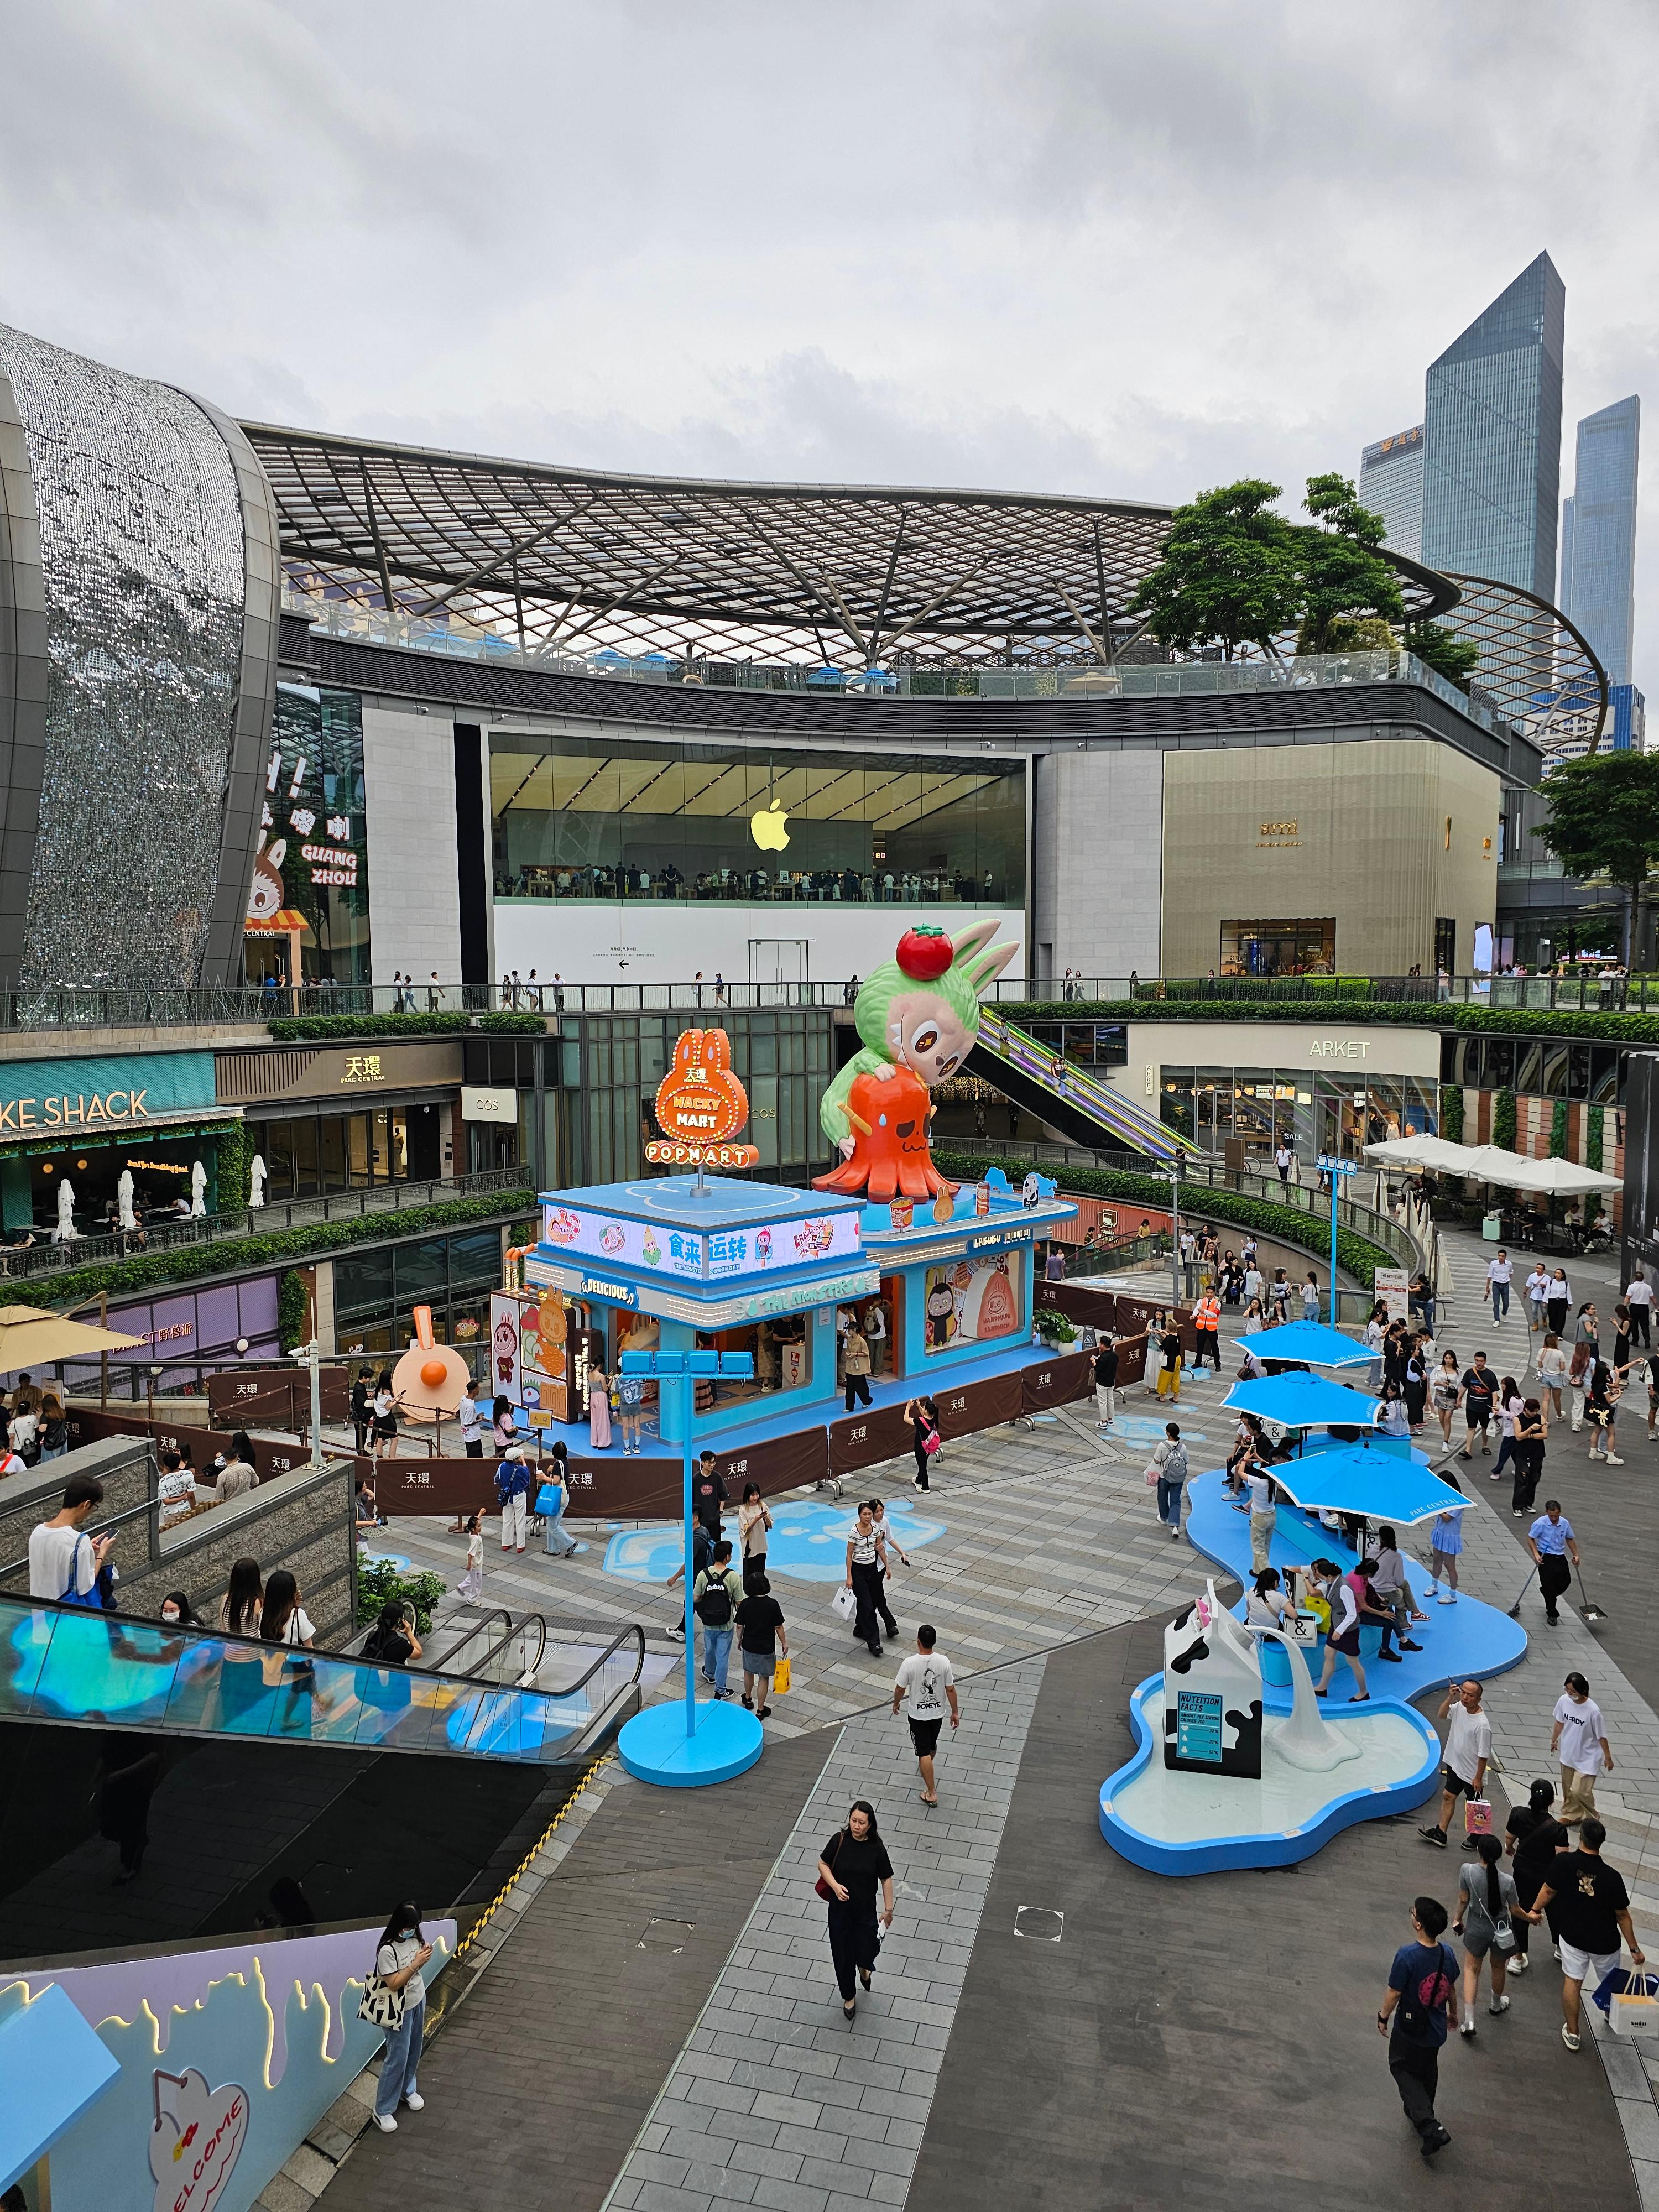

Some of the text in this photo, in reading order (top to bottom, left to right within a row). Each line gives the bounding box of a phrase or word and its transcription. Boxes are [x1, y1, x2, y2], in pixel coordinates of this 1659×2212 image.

[302, 845, 357, 869] GUANG
[312, 868, 357, 886] ZHOU
[1309, 1040, 1370, 1058] ARKET
[346, 1055, 381, 1077] 天環
[44, 1089, 149, 1125] SHACK
[476, 1099, 499, 1111] COS
[673, 1095, 721, 1111] WACKY
[676, 1113, 717, 1129] MART
[751, 1108, 776, 1119] COS
[41, 1125, 86, 1136] CUSTARD
[90, 1123, 116, 1132] FRIES
[120, 1118, 154, 1129] SHAKES
[206, 1110, 237, 1119] CONES
[973, 1234, 1001, 1248] LABUBU
[588, 1279, 629, 1301] DELICIOUS
[760, 1277, 854, 1312] THE MONSTERS
[159, 1321, 194, 1342] 野兽派
[236, 1384, 258, 1395] 天環
[623, 1385, 641, 1402] 87
[951, 1396, 965, 1411] 天環
[851, 1426, 867, 1441] 天環
[1271, 1426, 1280, 1437] &
[161, 1436, 177, 1449] 天環
[272, 1457, 290, 1471] 天環
[727, 1459, 747, 1476] 天環
[405, 1472, 430, 1484] 天環
[568, 1473, 593, 1485] 天環
[1409, 1498, 1459, 1517] PARC CENTRAL
[1294, 1621, 1307, 1636] &
[916, 1701, 941, 1710] POPEYE
[1180, 1703, 1203, 1712] FACTS
